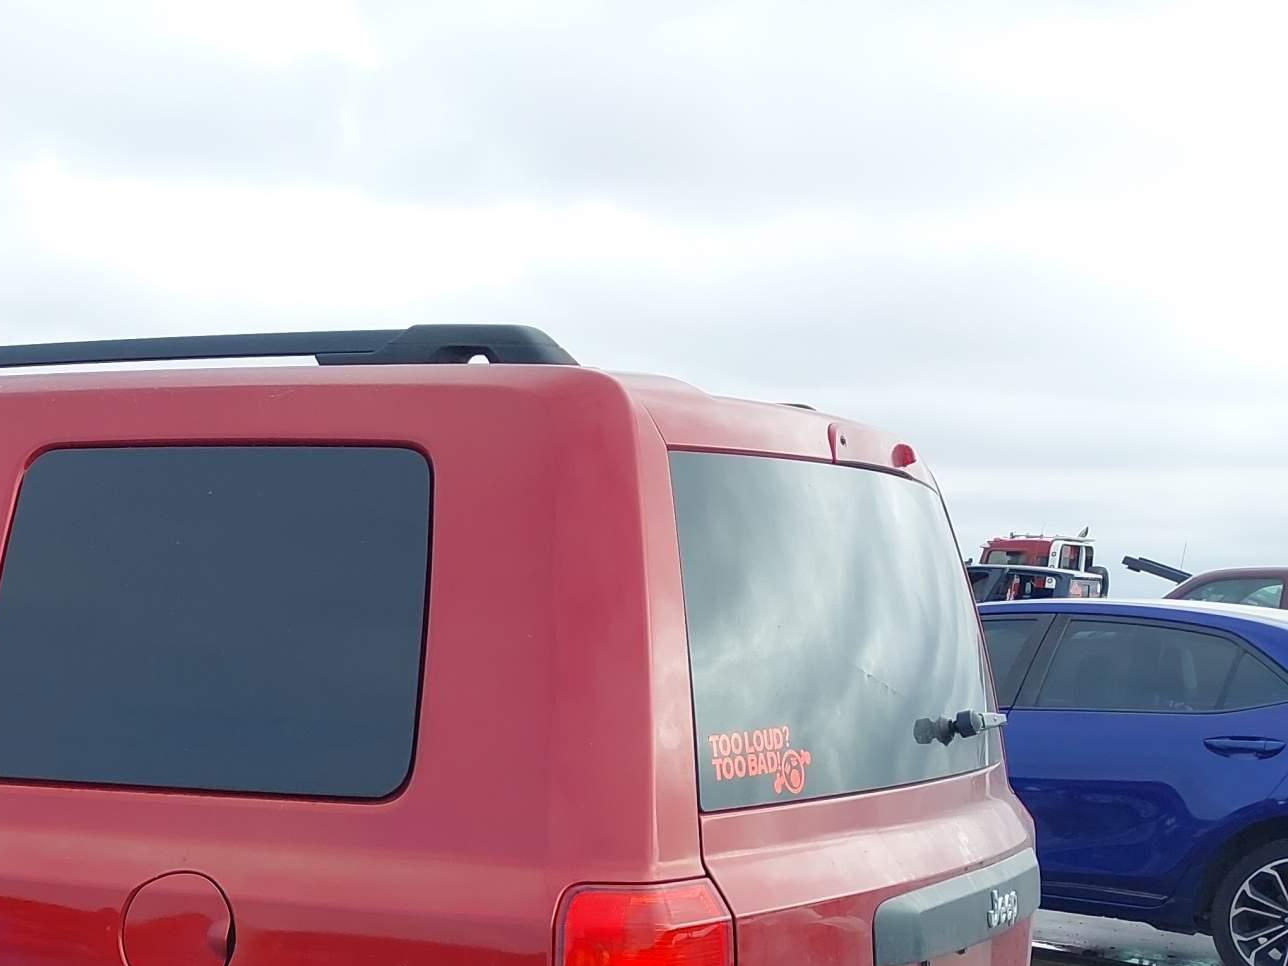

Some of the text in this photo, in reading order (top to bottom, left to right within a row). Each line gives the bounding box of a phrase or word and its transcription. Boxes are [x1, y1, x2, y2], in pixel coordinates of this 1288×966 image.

[709, 726, 790, 757] TOO LOUD?
[712, 751, 782, 781] TOO BAD!
[987, 889, 1018, 928] Jeep
